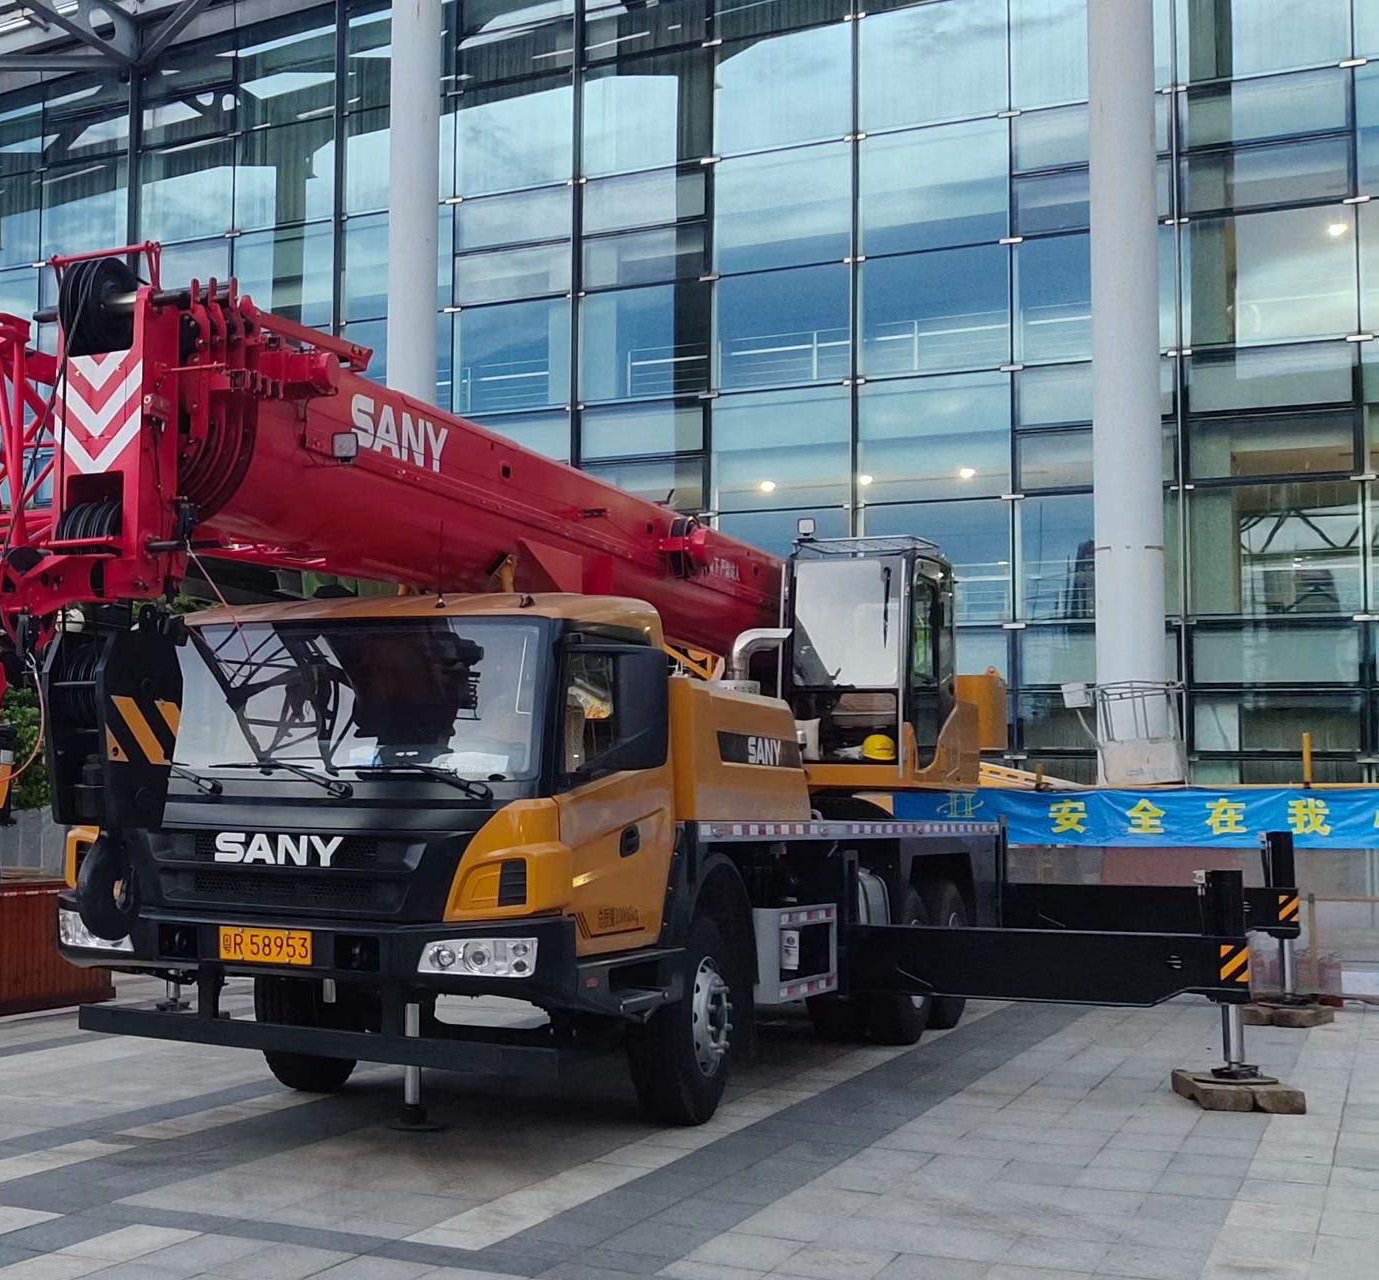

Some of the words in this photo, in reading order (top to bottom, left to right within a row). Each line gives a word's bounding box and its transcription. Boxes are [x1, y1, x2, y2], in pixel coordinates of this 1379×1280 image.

[351, 393, 449, 473] SANY
[747, 736, 781, 766] SANY
[1048, 798, 1379, 836] 安全在我
[214, 832, 345, 867] SANY
[250, 934, 309, 959] 58953
